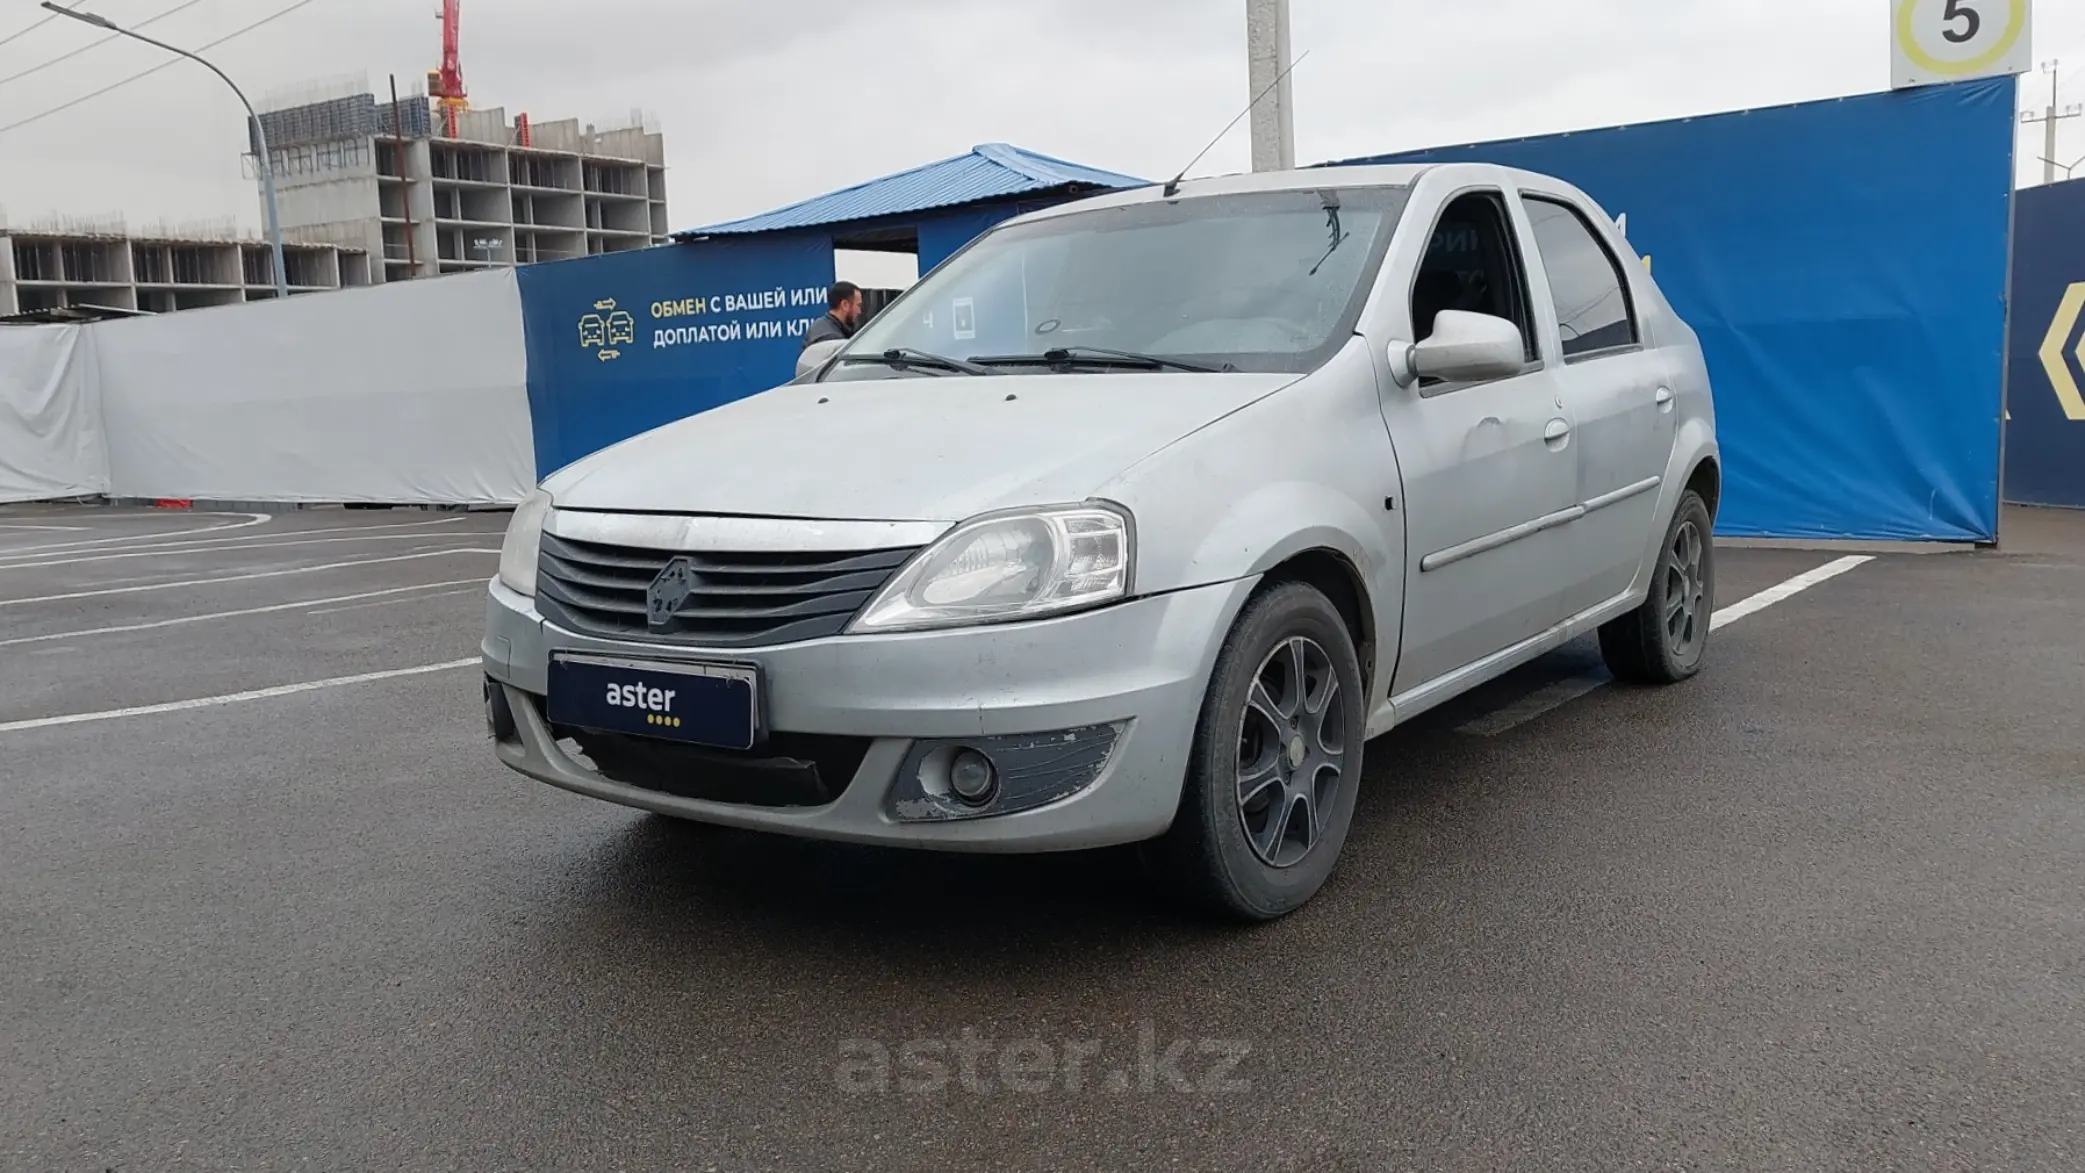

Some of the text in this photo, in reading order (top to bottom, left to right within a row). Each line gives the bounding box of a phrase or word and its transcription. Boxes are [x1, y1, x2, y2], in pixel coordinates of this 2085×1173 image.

[1942, 0, 1980, 43] 5
[650, 287, 828, 318] ОБМЕН С ВАШЕЙ ИЛИ
[653, 318, 815, 349] ДОПЛАТОЙ ИЛИ КЛ
[606, 681, 676, 712] aster
